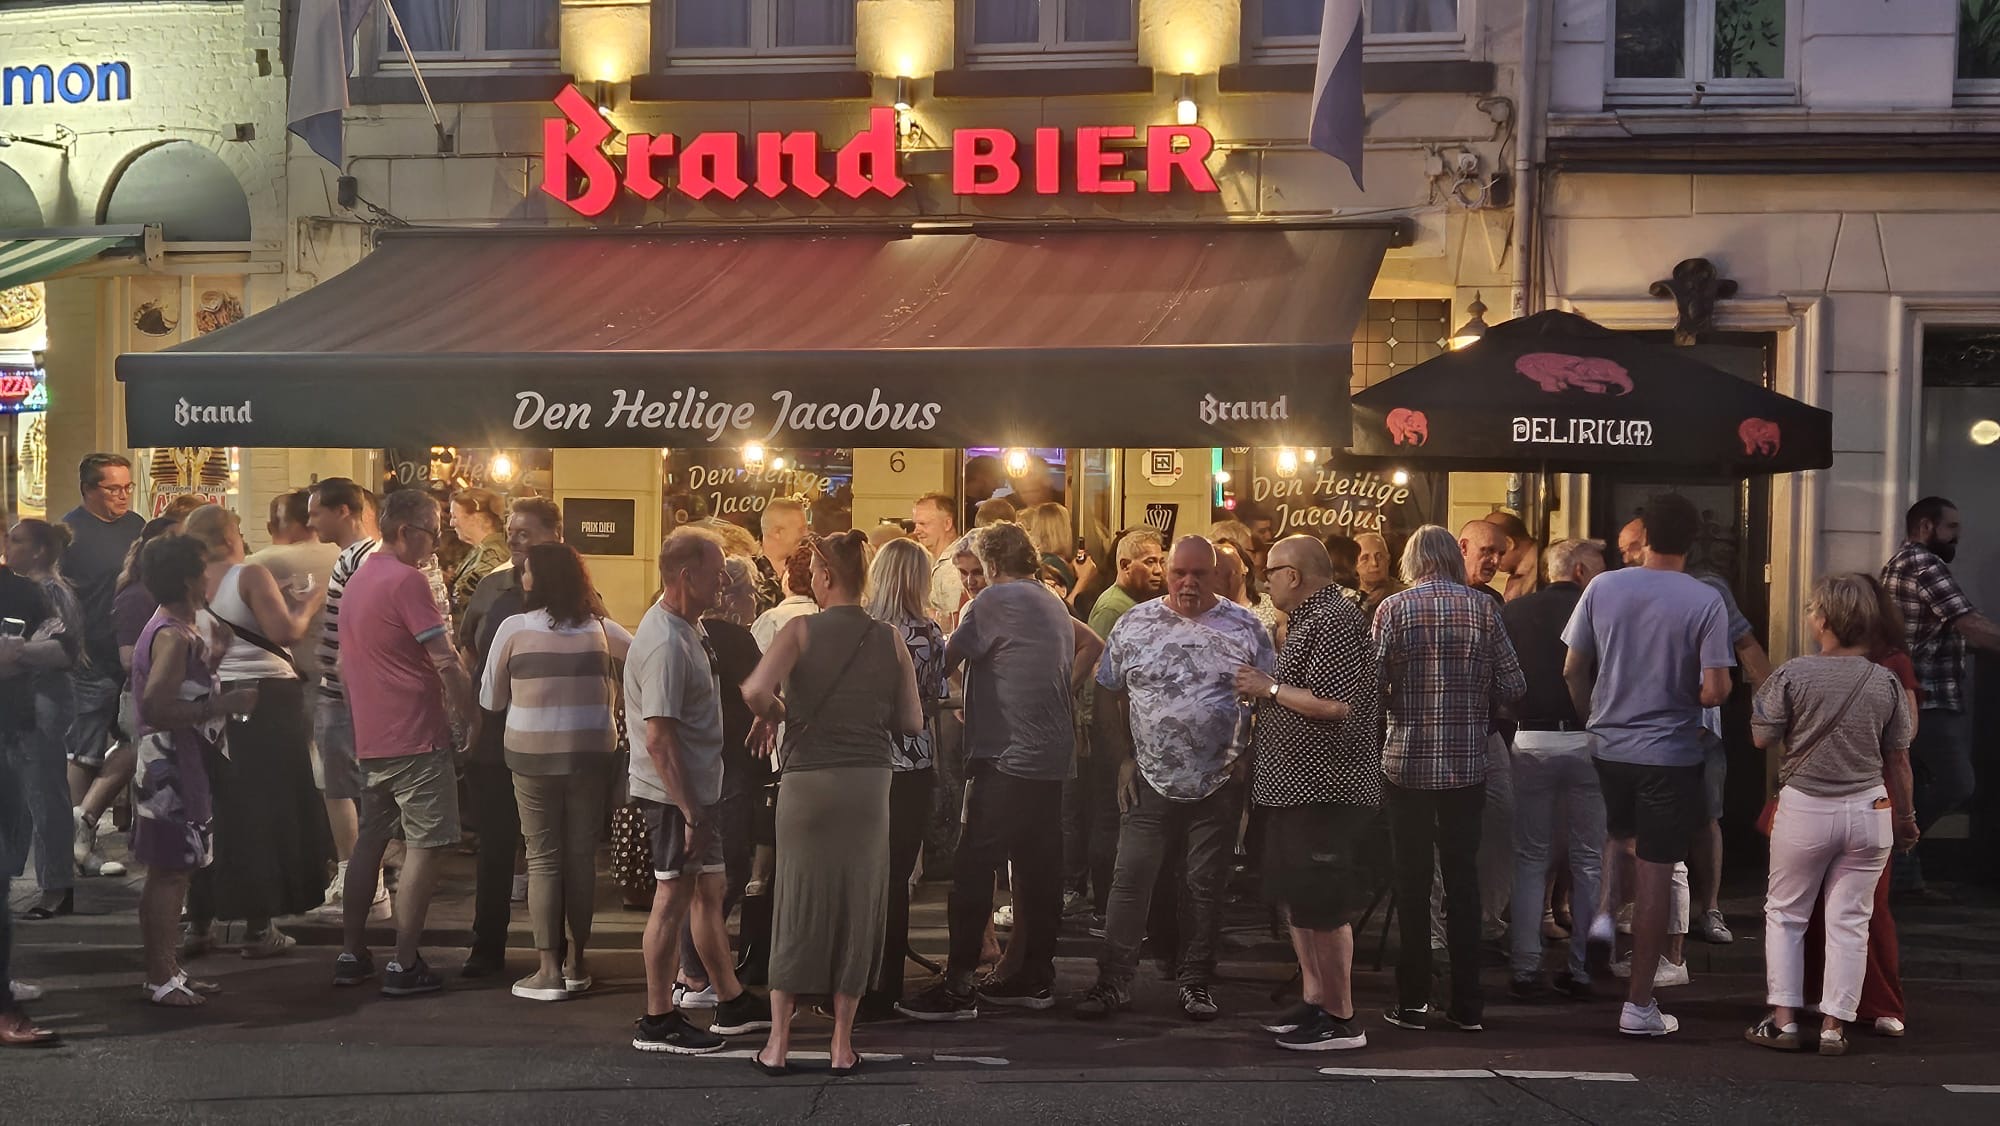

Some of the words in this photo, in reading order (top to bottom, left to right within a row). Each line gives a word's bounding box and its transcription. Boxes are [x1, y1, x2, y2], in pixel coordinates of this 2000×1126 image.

[3, 61, 131, 105] mon
[541, 83, 906, 216] Brand
[952, 125, 1220, 194] BIER
[175, 397, 252, 426] Brand
[513, 391, 592, 430] Den
[605, 387, 755, 442] Heilige
[765, 387, 941, 442] Jacobus
[1200, 393, 1288, 425] Brand
[1512, 417, 1653, 446] DELIRIUM
[689, 465, 735, 490] Den
[890, 451, 905, 473] 6
[1254, 476, 1303, 502] Den
[1312, 470, 1409, 507] Heilige
[1274, 500, 1387, 539] Jacobus
